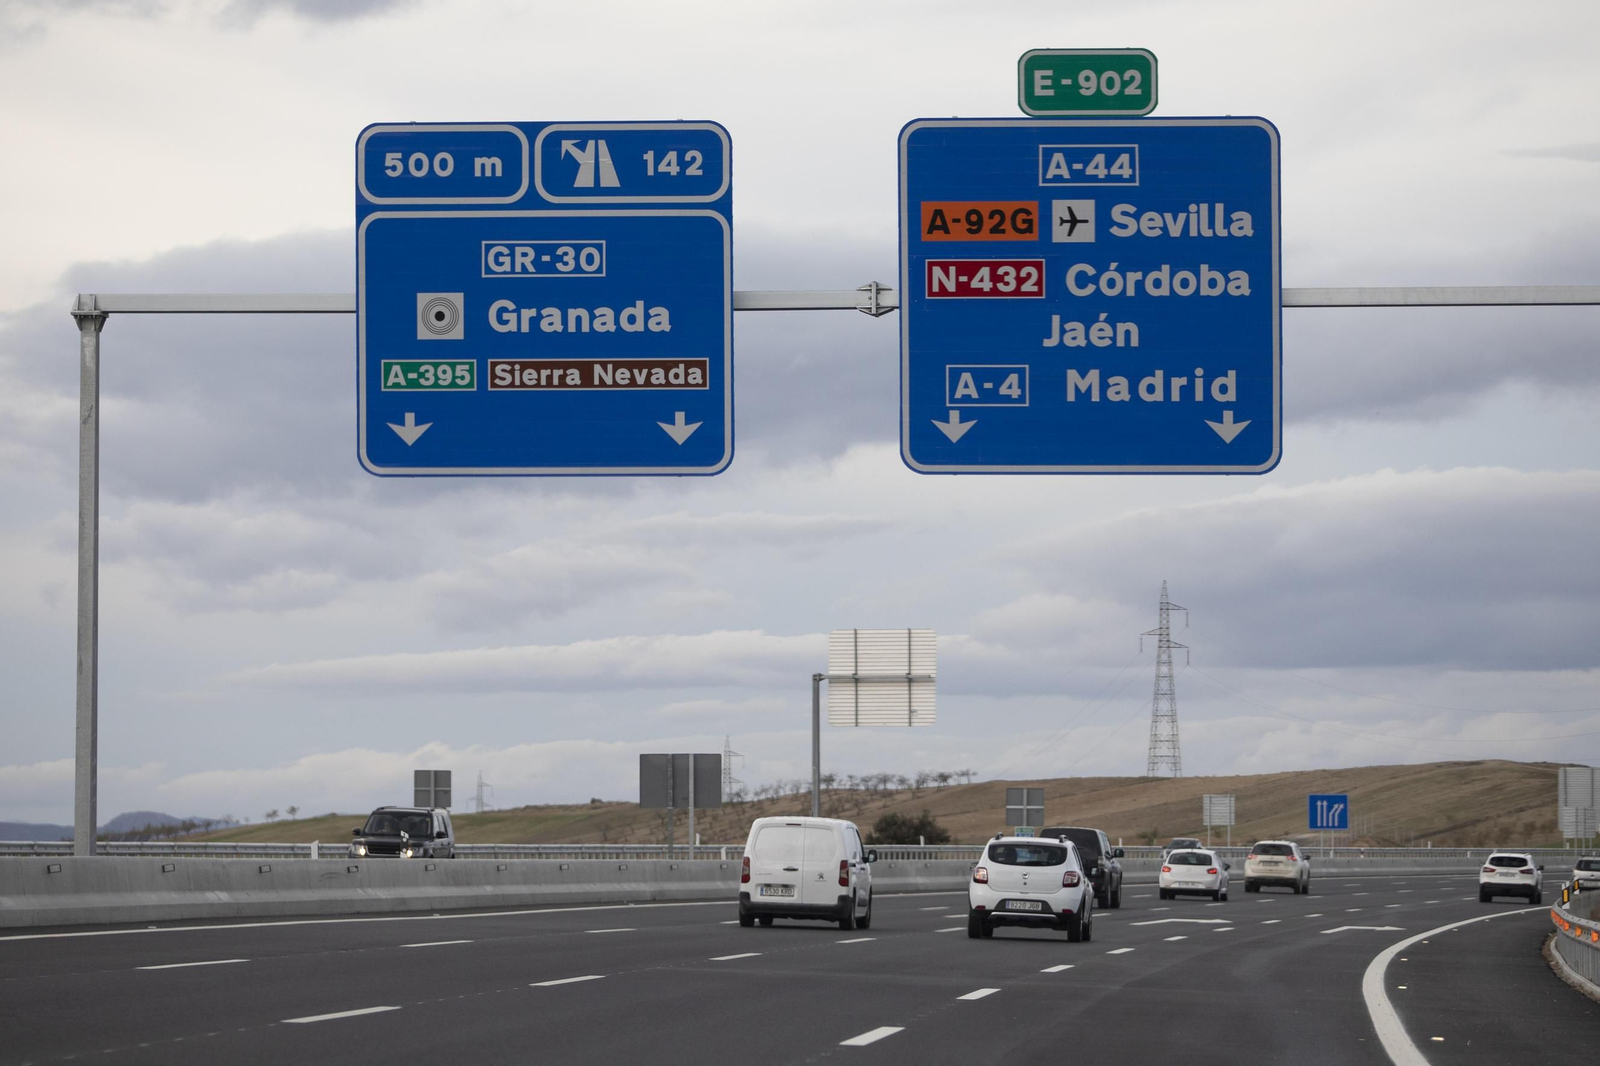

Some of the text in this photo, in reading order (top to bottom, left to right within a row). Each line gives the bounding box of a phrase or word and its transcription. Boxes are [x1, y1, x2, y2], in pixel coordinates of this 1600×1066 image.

[1034, 70, 1142, 96] E-902
[385, 152, 502, 178] 500 m
[643, 150, 703, 176] 142
[1046, 153, 1132, 179] A-44
[926, 208, 1034, 235] A-92G
[1109, 203, 1254, 237] Sevilla
[487, 246, 601, 272] GR-30
[932, 266, 1039, 292] N-432
[1066, 263, 1251, 296] Córdoba
[488, 300, 671, 332] Granada
[1043, 313, 1139, 347] Jaén
[386, 365, 470, 386] A-395
[493, 364, 703, 386] Sierra Nevada
[954, 373, 1021, 398] A-4
[1066, 368, 1237, 402] Madrid
